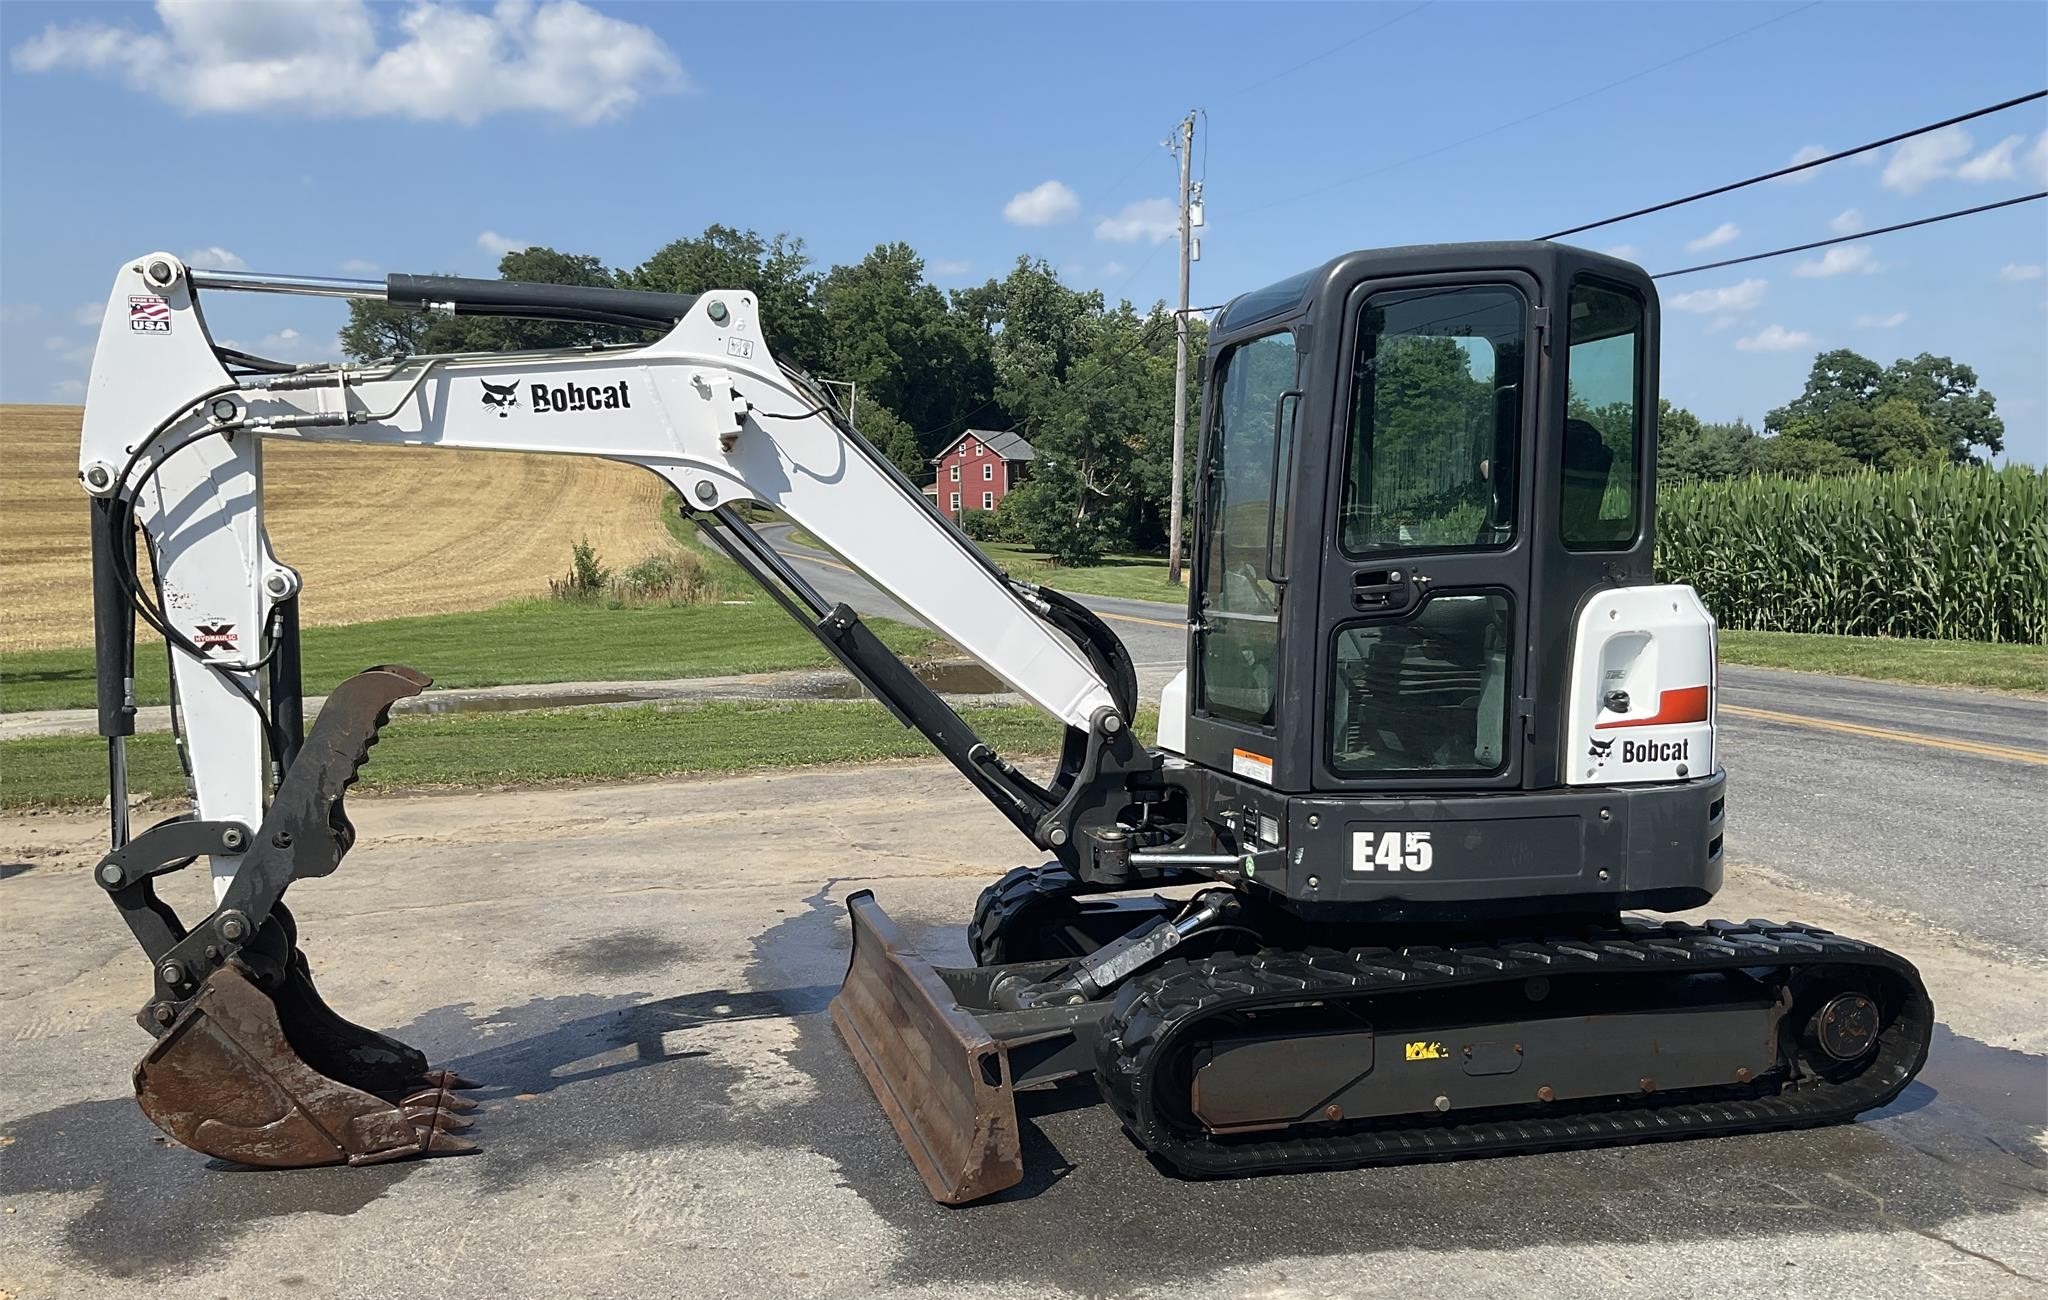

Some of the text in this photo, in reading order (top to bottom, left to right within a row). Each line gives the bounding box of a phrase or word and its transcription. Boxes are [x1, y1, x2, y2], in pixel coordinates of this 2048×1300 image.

[133, 320, 168, 330] USA
[530, 380, 631, 413] Bobcat
[195, 634, 237, 642] HYDRAULIC
[1622, 738, 1689, 763] Bobcat
[1352, 831, 1433, 872] E45
